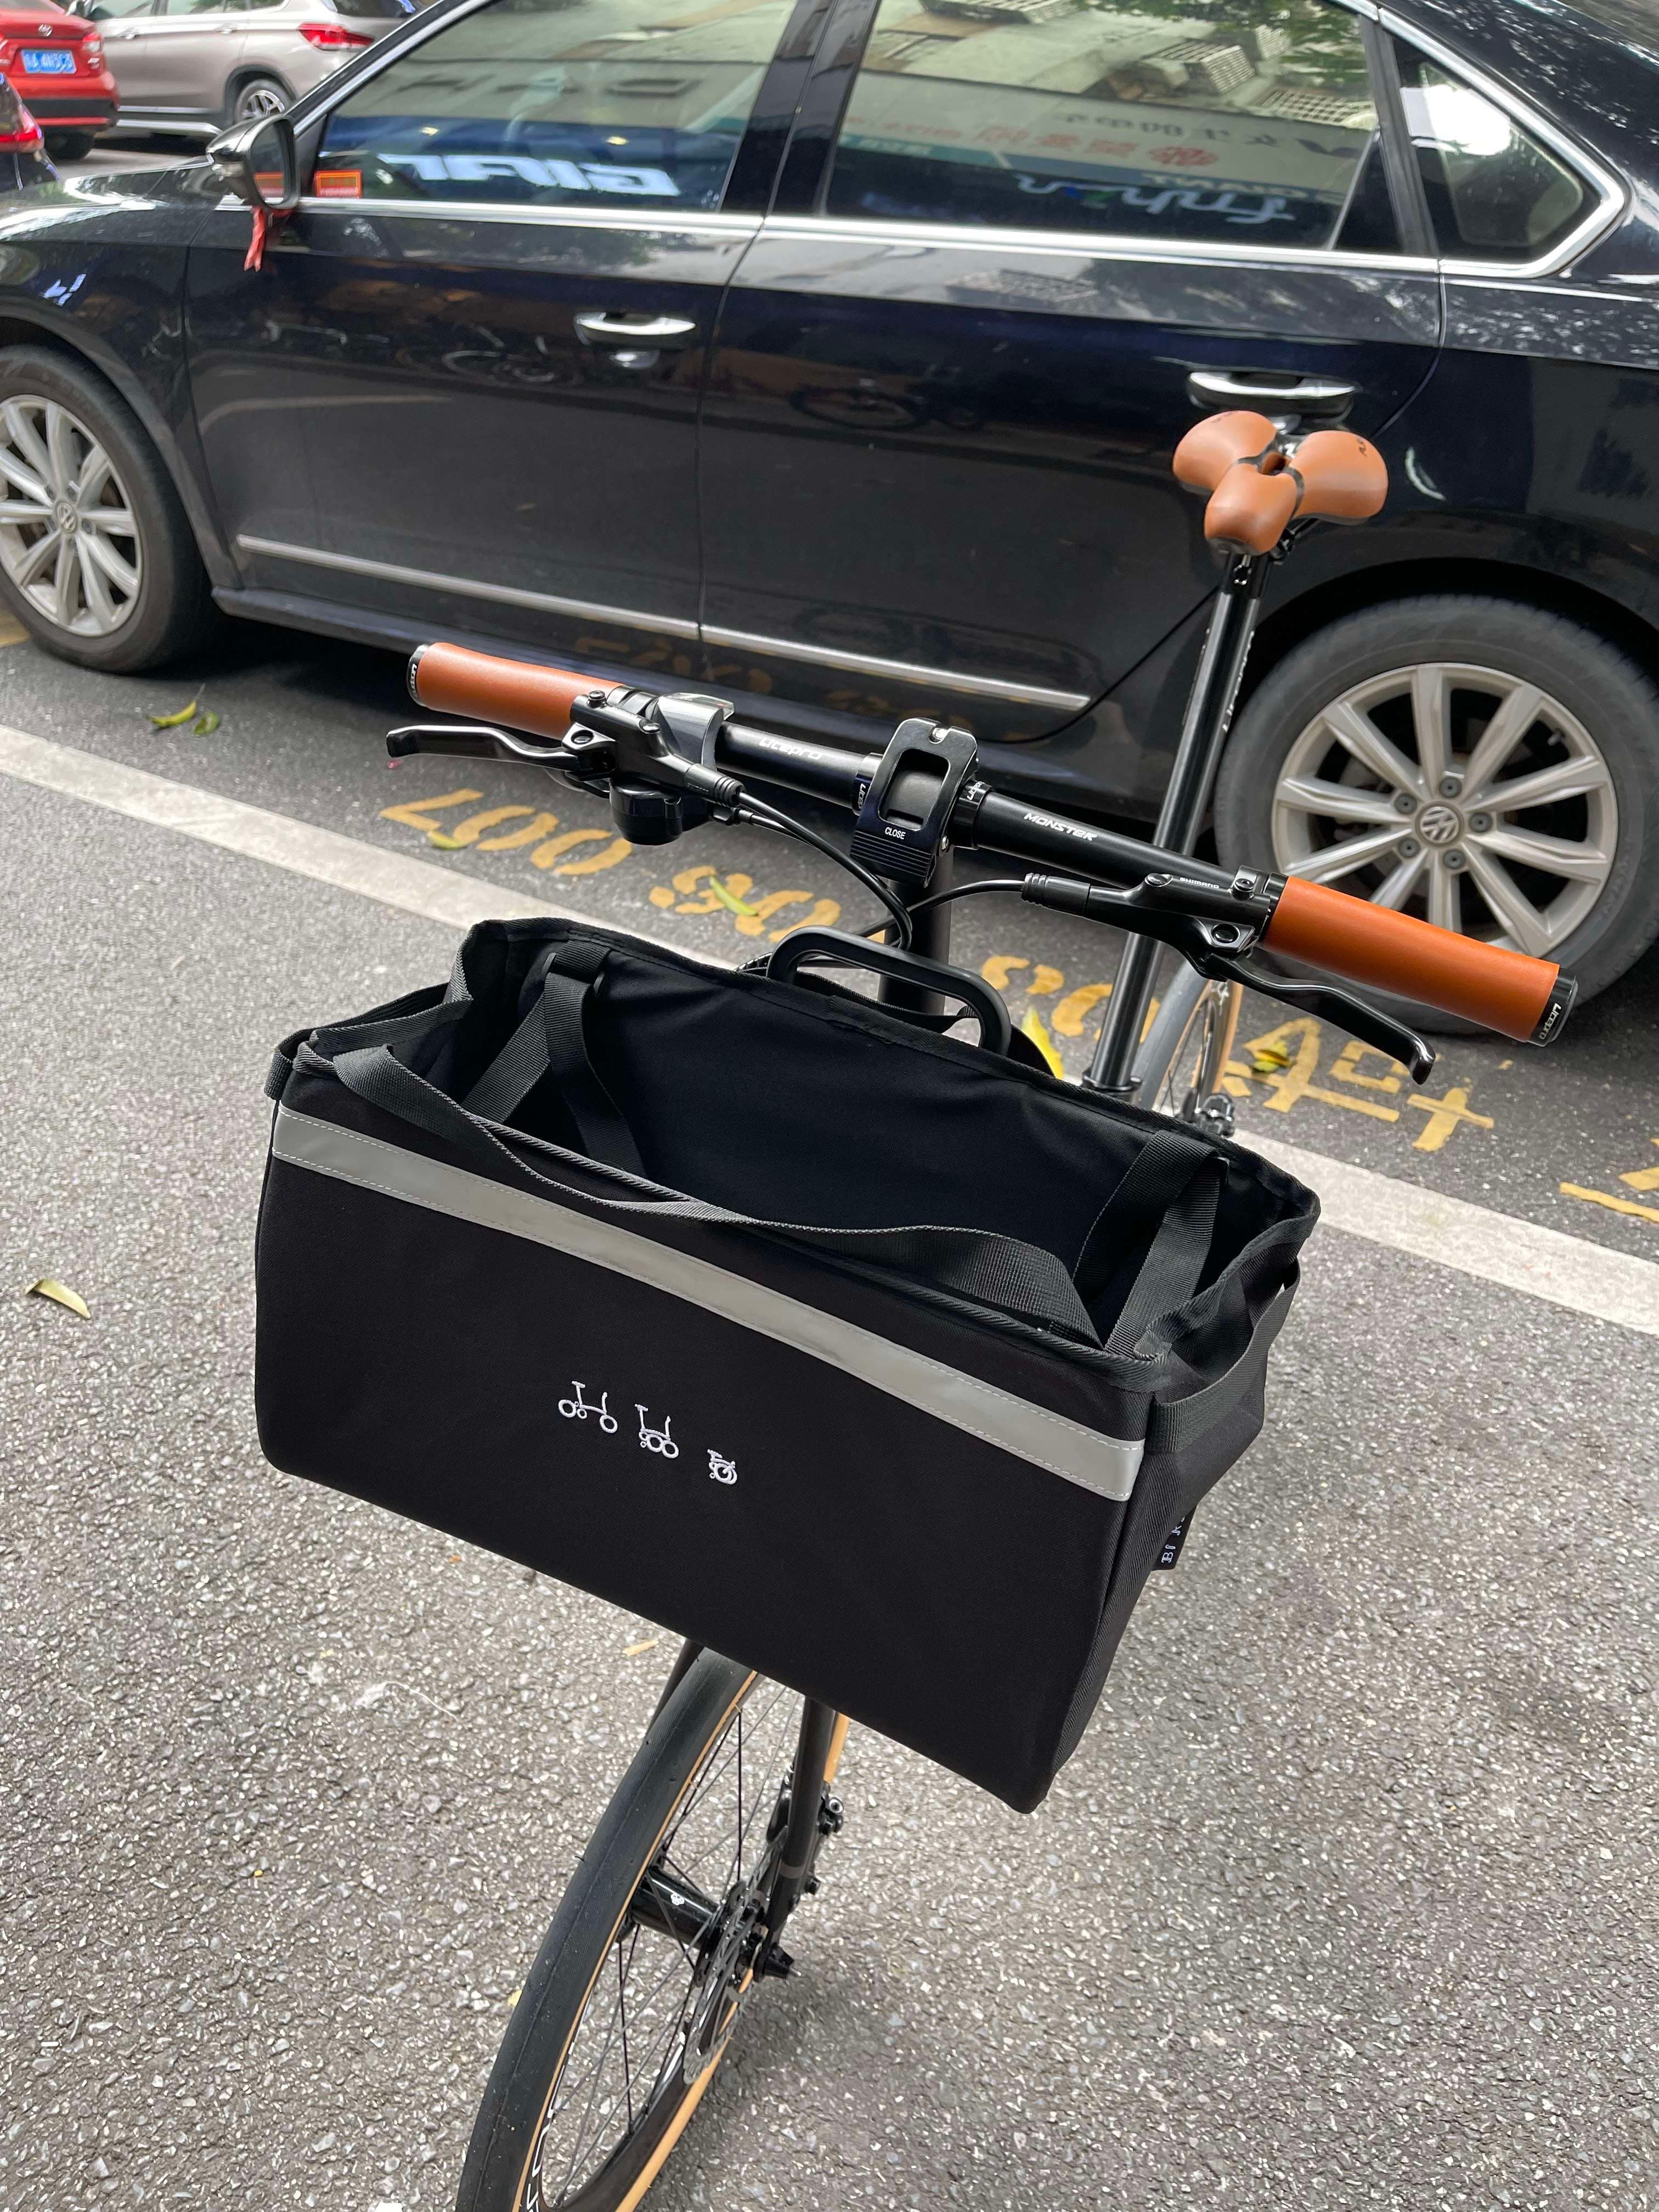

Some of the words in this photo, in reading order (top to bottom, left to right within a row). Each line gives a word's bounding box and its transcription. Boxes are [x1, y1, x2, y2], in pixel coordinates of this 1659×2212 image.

[1024, 812, 1098, 841] MONSTER
[885, 827, 906, 839] CLOSE
[1180, 877, 1220, 889] SHIMANO
